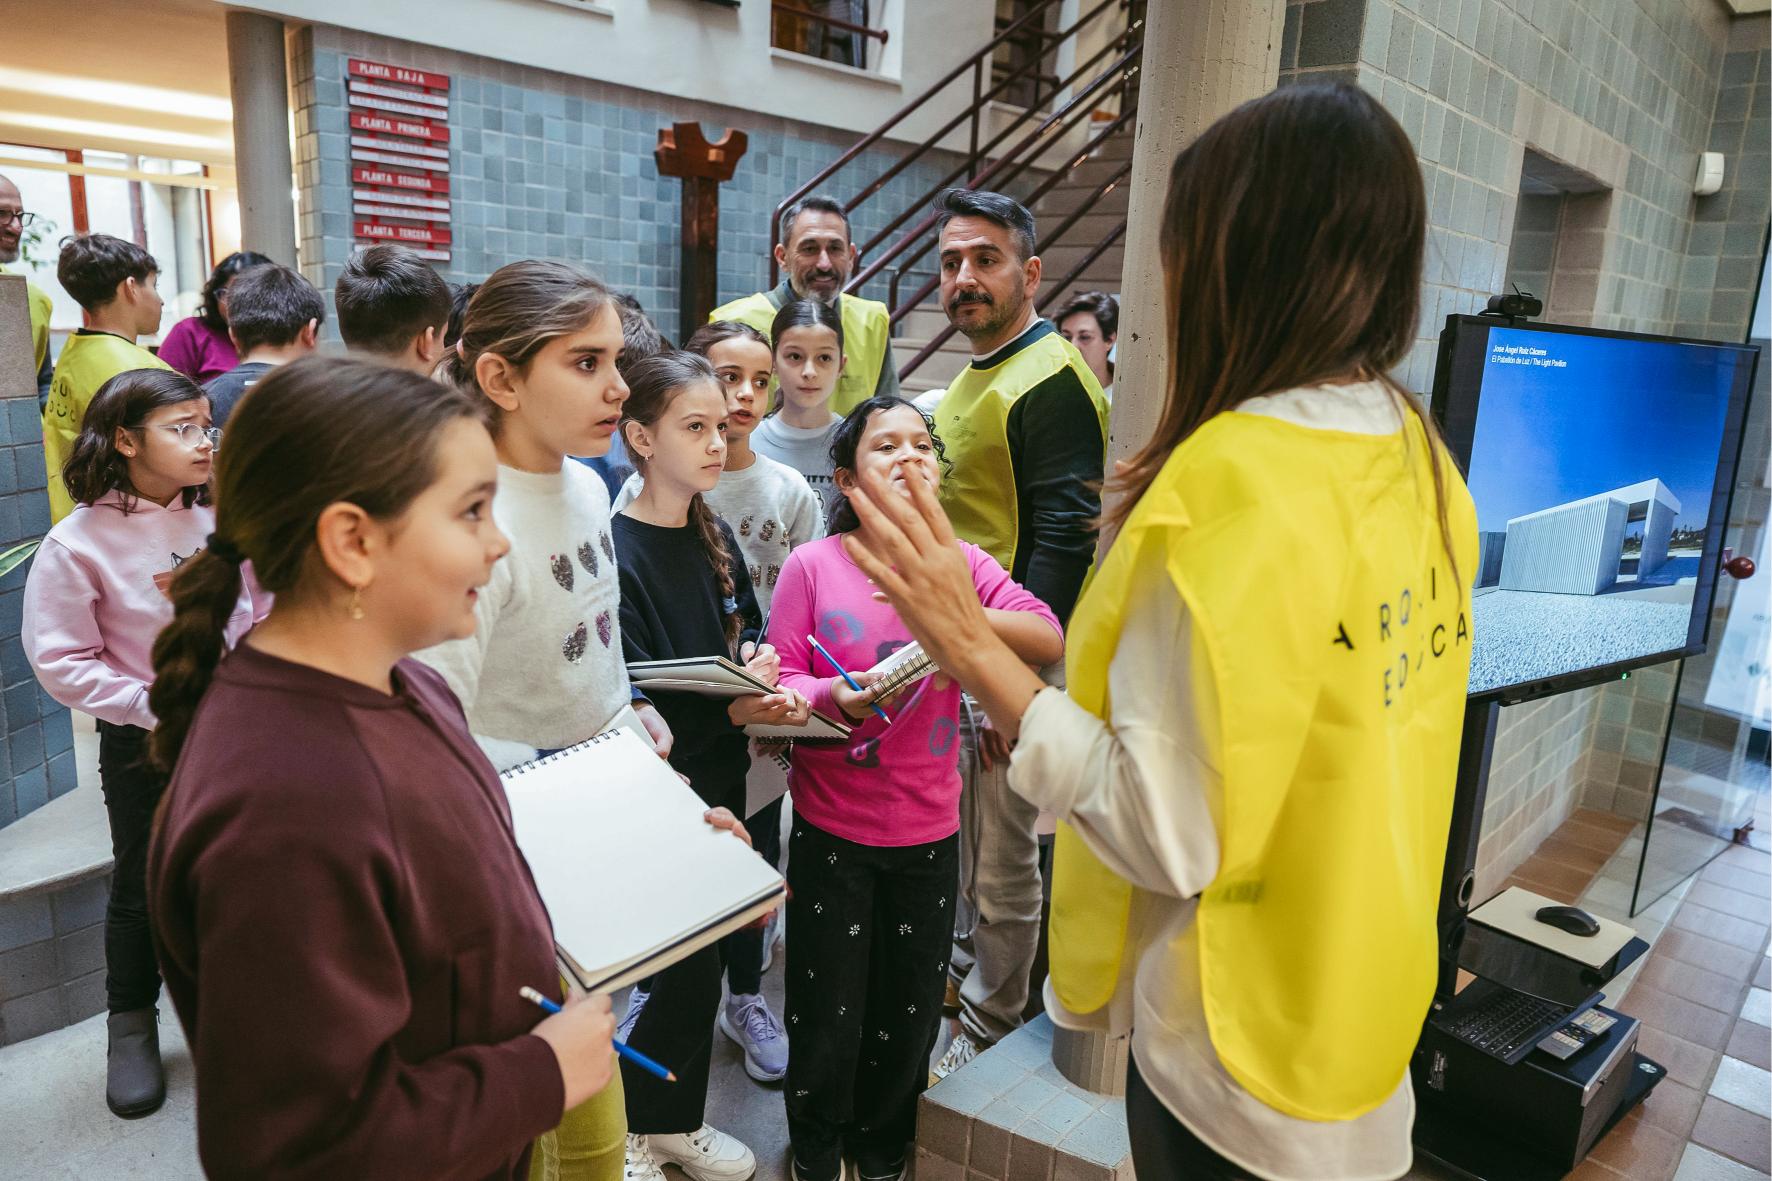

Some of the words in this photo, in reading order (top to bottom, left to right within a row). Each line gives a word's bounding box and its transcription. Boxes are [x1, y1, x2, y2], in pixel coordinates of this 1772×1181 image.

[359, 63, 390, 78] PLANTA
[397, 69, 425, 83] BAJA
[360, 117, 391, 130] PLANTA
[397, 122, 431, 137] PRIMERA
[362, 171, 393, 184] PLANTA
[398, 175, 431, 188] SEGUNDA
[363, 224, 394, 237] PLANTA
[399, 227, 432, 240] TERCERA
[1505, 344, 1518, 355] Ángel
[1519, 347, 1529, 355] Ruiz
[1491, 355, 1497, 363] El
[1497, 355, 1515, 364] Pabellón
[1522, 357, 1530, 365] Luz
[1533, 358, 1541, 366] The
[1541, 359, 1551, 367] Light
[1551, 360, 1567, 368] Pavilion
[803, 475, 833, 483] ITTY
